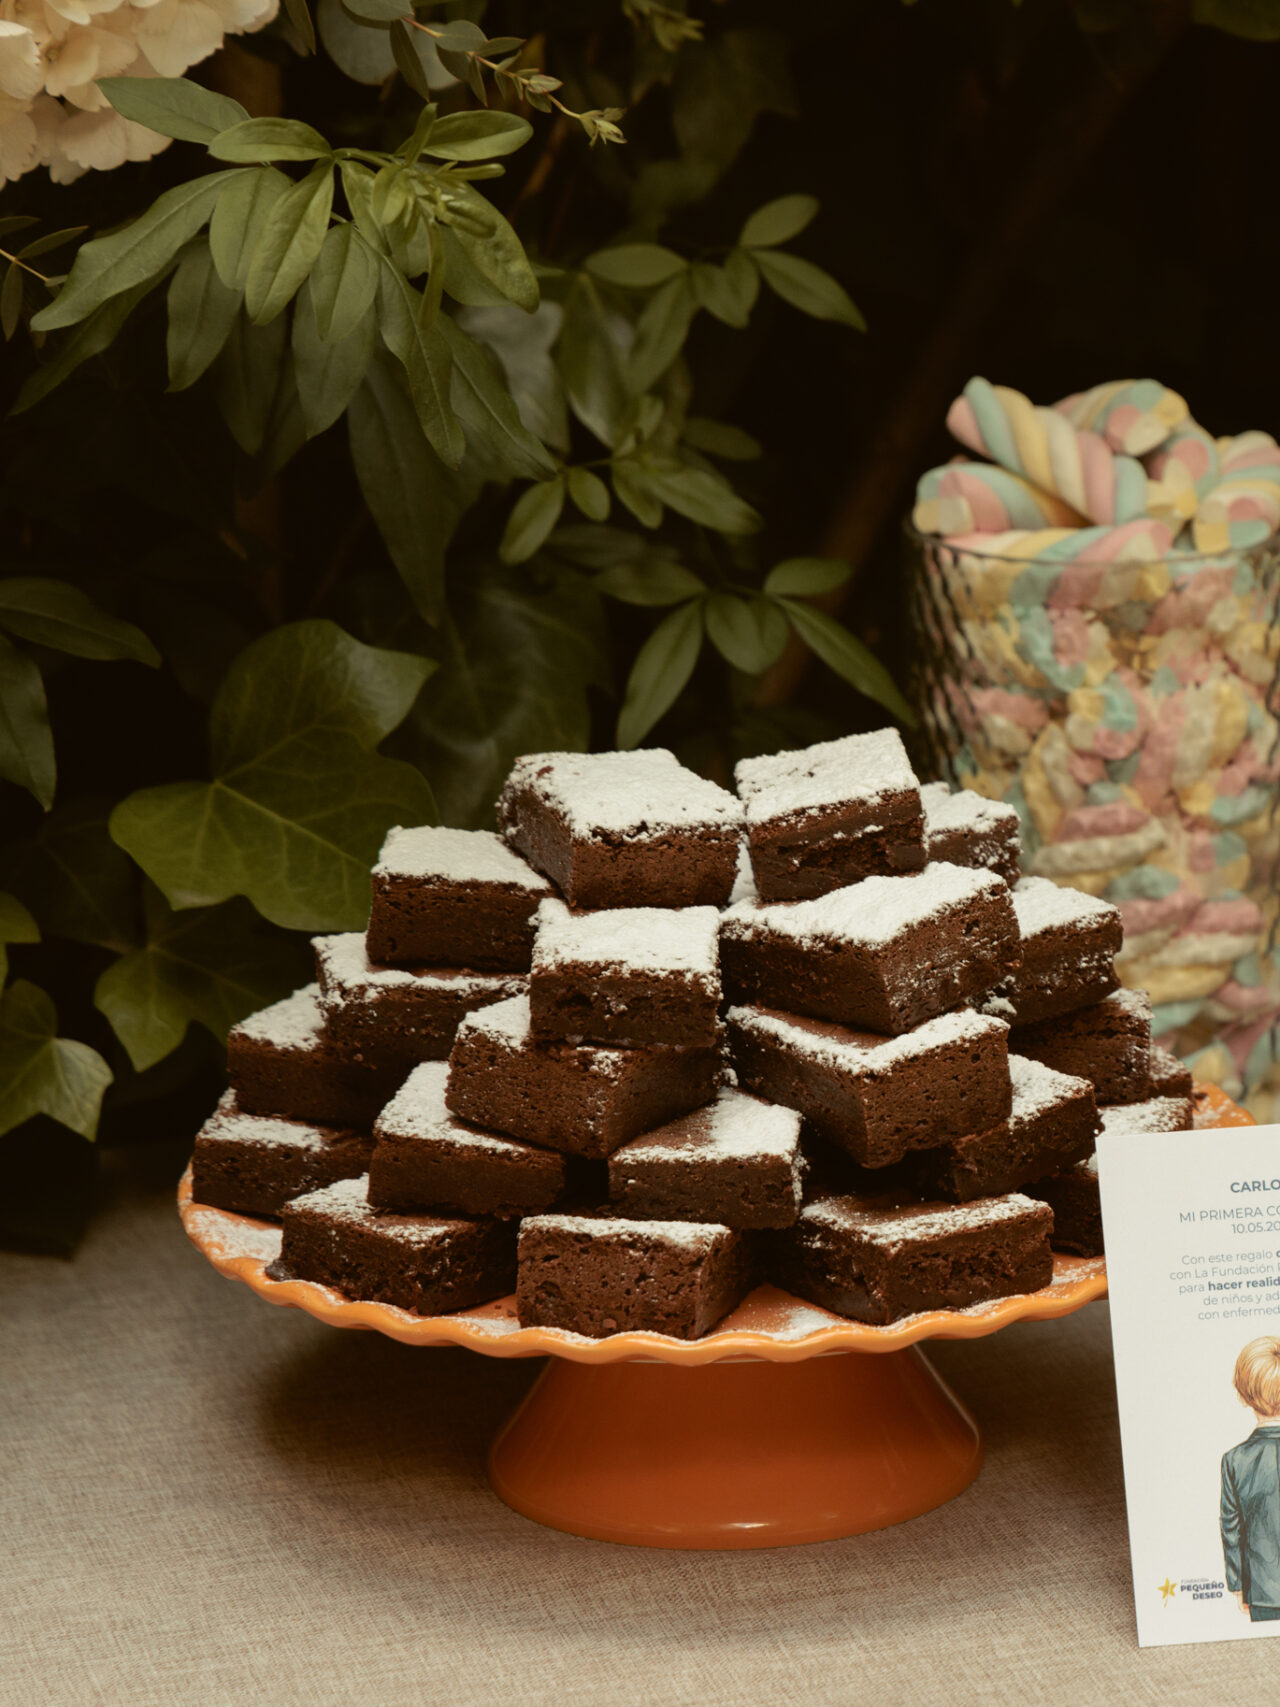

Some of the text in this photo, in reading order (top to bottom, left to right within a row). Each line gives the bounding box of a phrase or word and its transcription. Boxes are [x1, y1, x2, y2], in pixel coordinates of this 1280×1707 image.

[1179, 1211, 1195, 1223] MI
[1199, 1206, 1264, 1221] PRIMERA
[1181, 1254, 1205, 1265] Con
[1208, 1252, 1233, 1263] este
[1236, 1249, 1273, 1263] regalo
[1169, 1270, 1192, 1280] con
[1194, 1268, 1208, 1279] La
[1211, 1262, 1274, 1277] Fundación
[1178, 1283, 1205, 1296] para
[1207, 1280, 1243, 1292] hacer
[1202, 1295, 1218, 1306] de
[1221, 1292, 1254, 1305] niños
[1255, 1293, 1263, 1304] y
[1197, 1310, 1220, 1321] con
[1180, 1581, 1225, 1592] PEQUEÑO
[1192, 1591, 1223, 1600] DESEO
